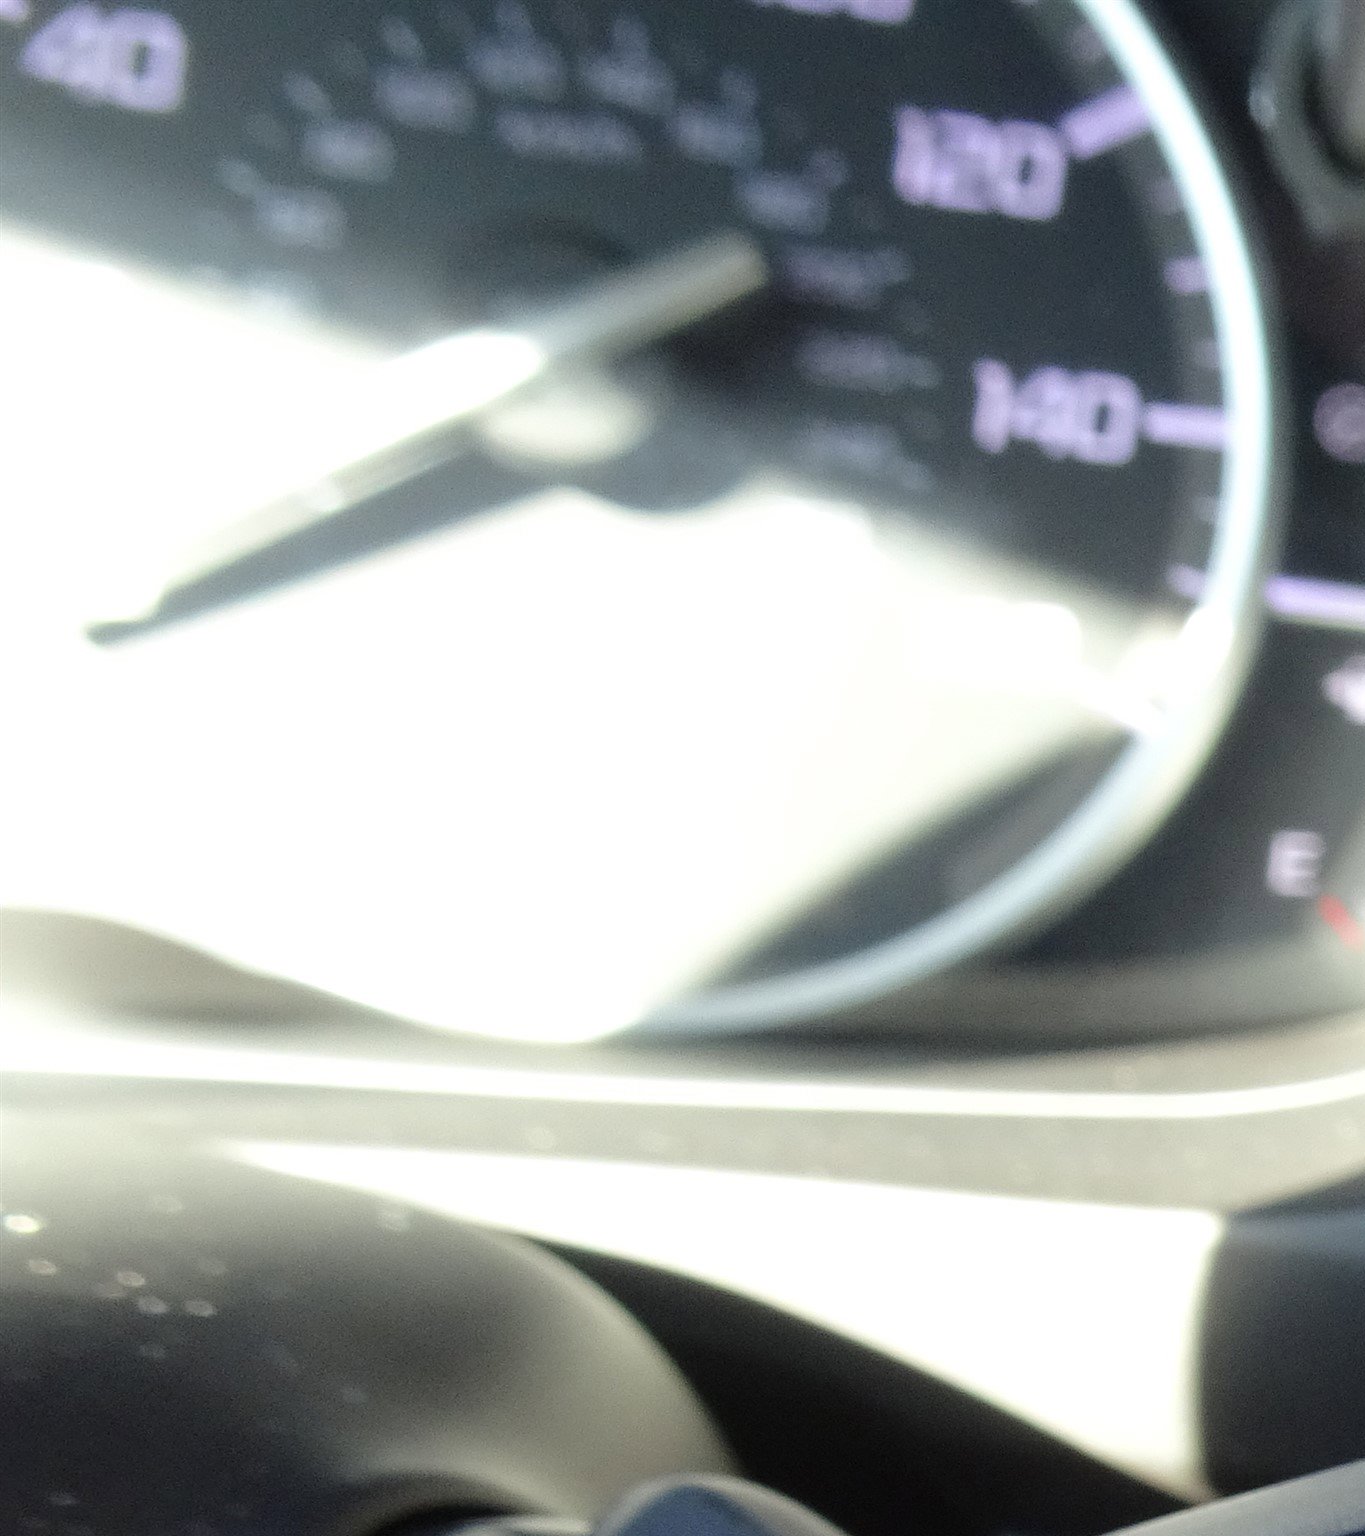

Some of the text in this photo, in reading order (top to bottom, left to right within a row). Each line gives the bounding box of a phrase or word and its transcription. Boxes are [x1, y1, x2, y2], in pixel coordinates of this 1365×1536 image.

[22, 4, 187, 112] 40
[892, 105, 1067, 221] 120
[972, 357, 1143, 467] 140
[1267, 829, 1326, 898] E
